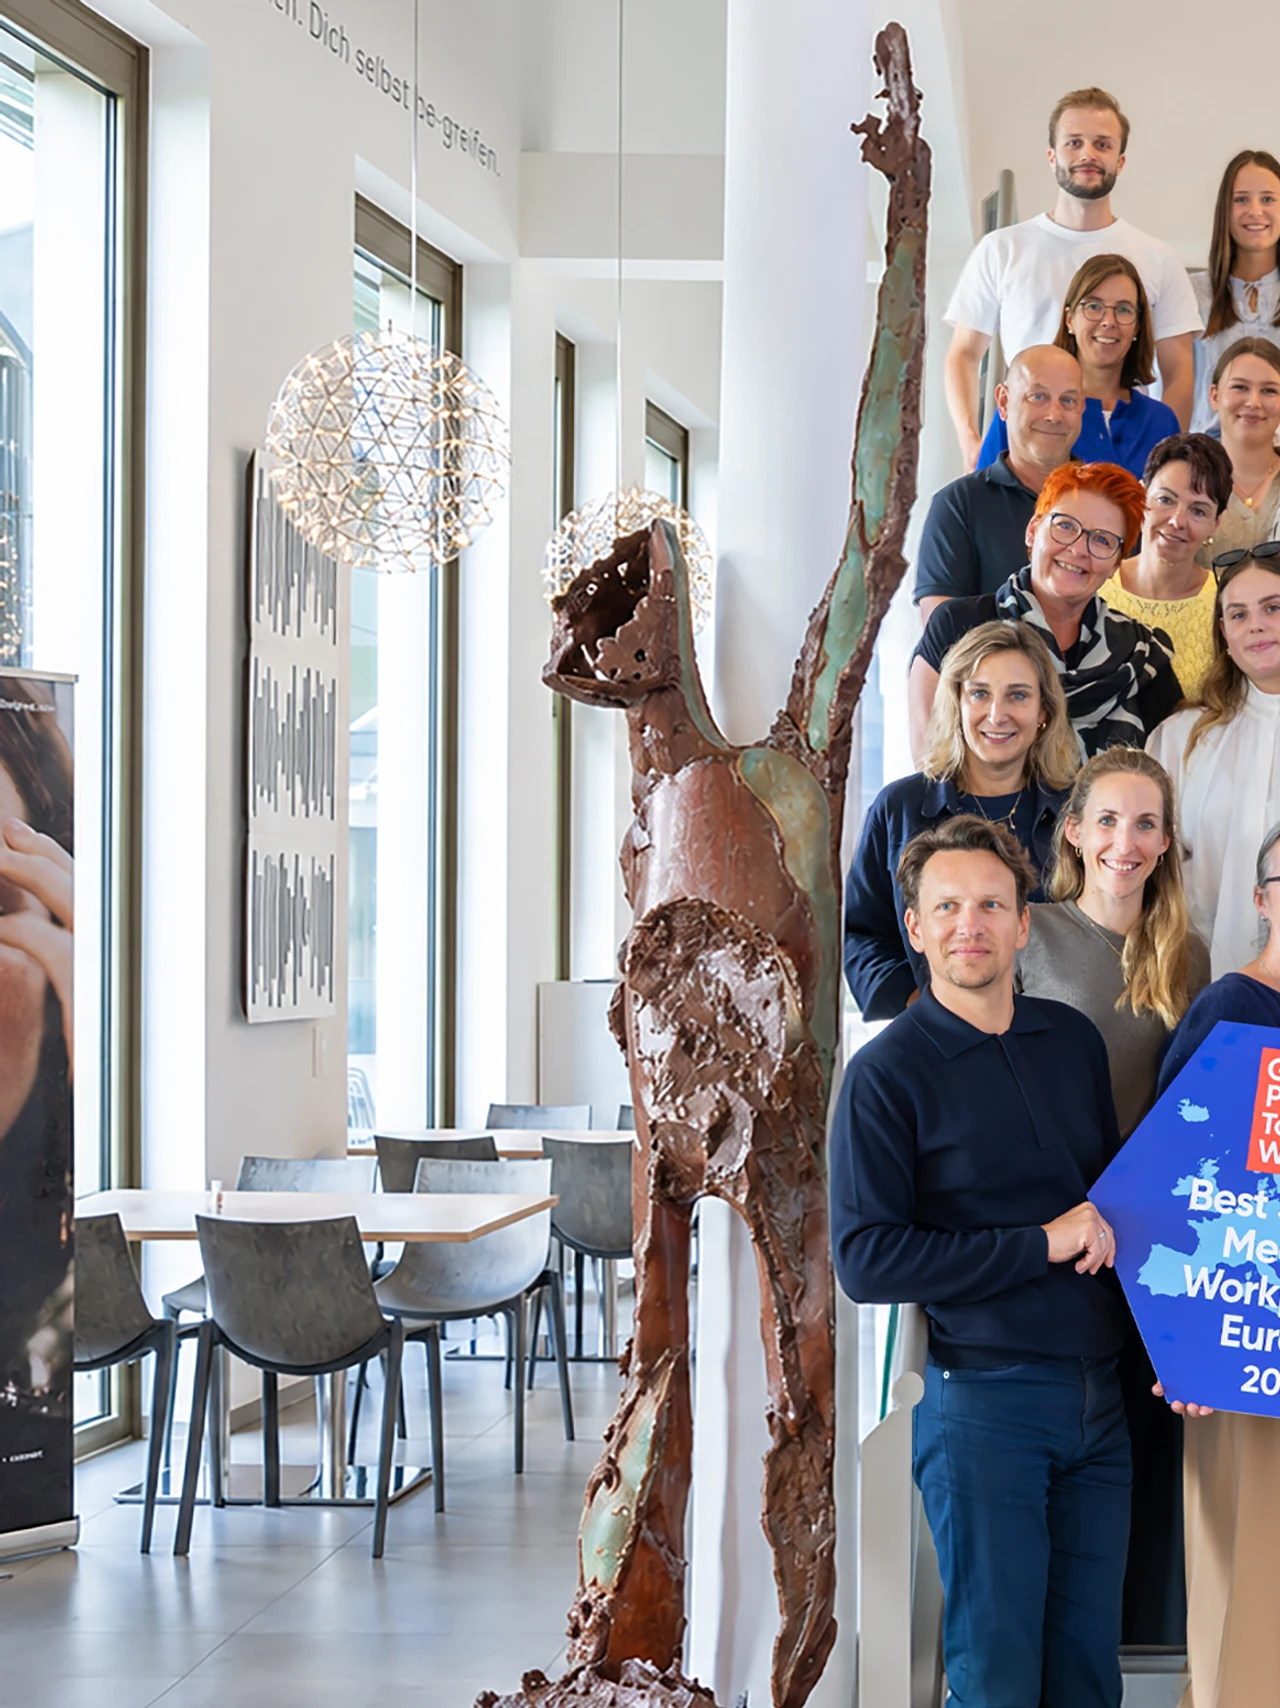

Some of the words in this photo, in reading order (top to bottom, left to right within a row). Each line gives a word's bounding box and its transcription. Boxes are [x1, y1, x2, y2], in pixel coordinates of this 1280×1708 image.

[309, 1, 350, 63] Dich
[356, 49, 410, 110] selbst
[1189, 1177, 1269, 1219] Best
